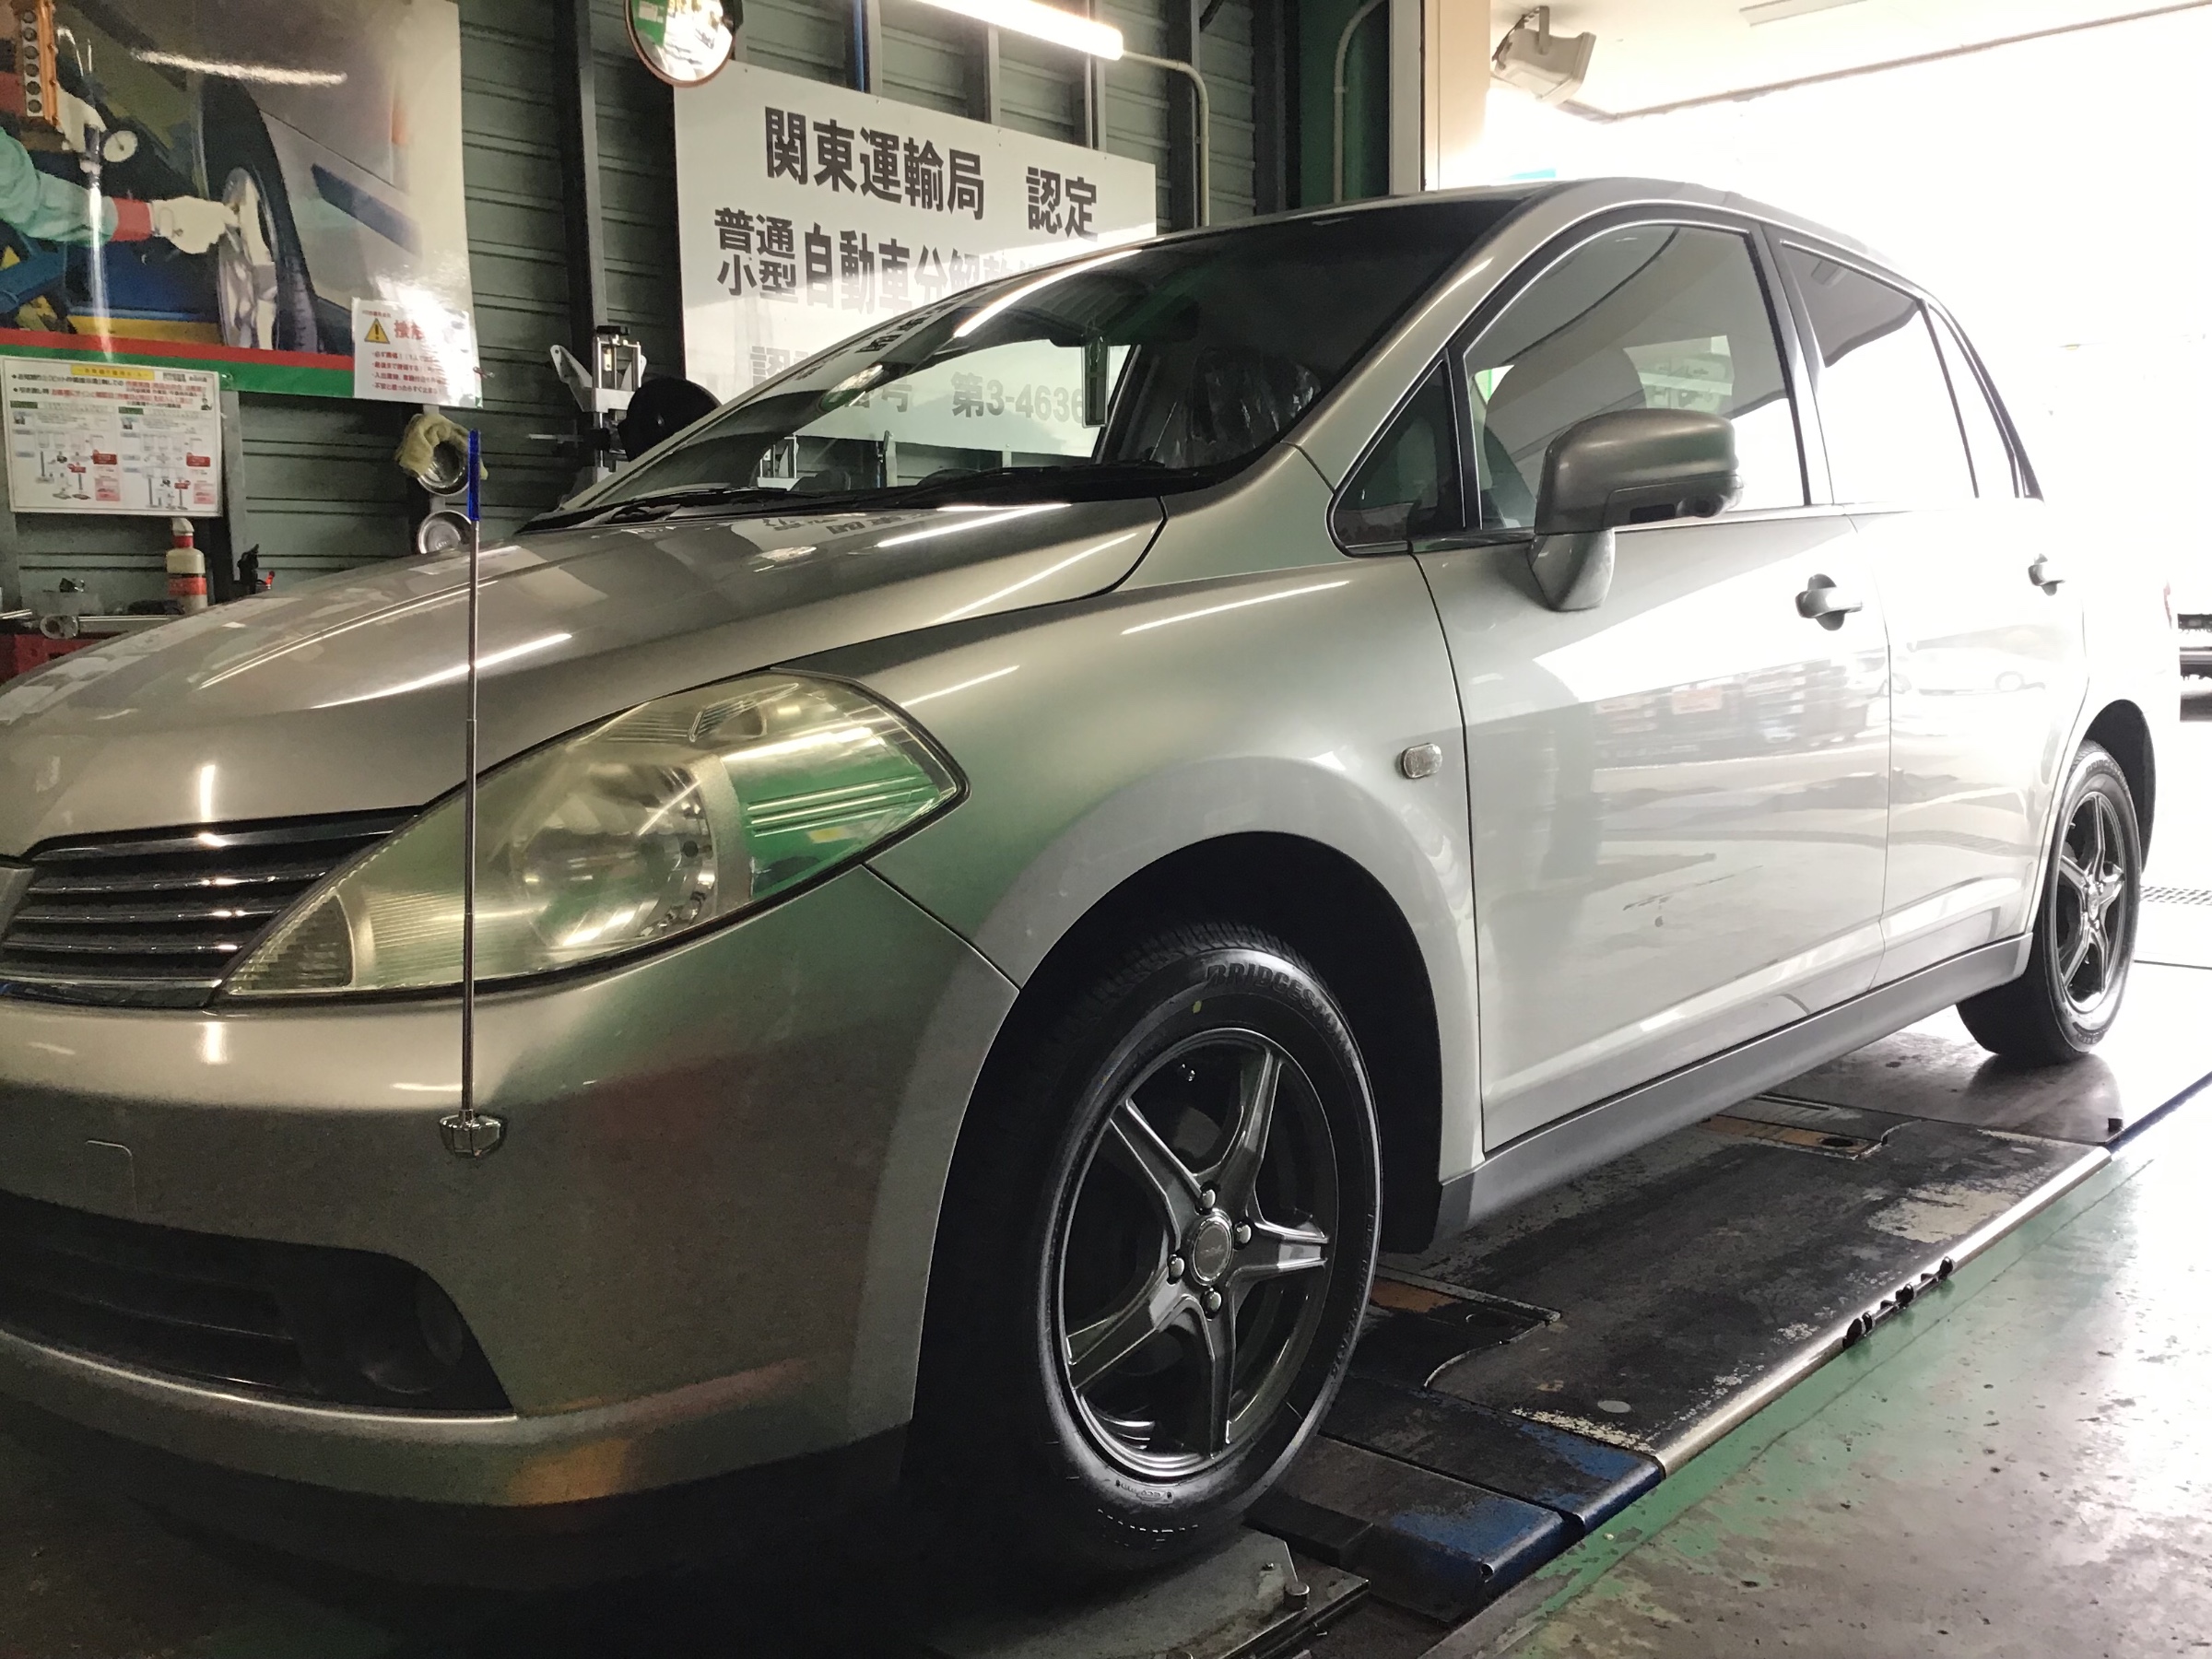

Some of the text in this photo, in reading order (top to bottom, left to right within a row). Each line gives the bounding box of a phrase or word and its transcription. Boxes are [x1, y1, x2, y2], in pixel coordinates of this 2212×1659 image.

[765, 106, 1098, 241] 関東運輸局 認定
[714, 207, 795, 259] 普通
[717, 254, 798, 303] 小型
[1203, 963, 1359, 1069] BRIDGESTONE
